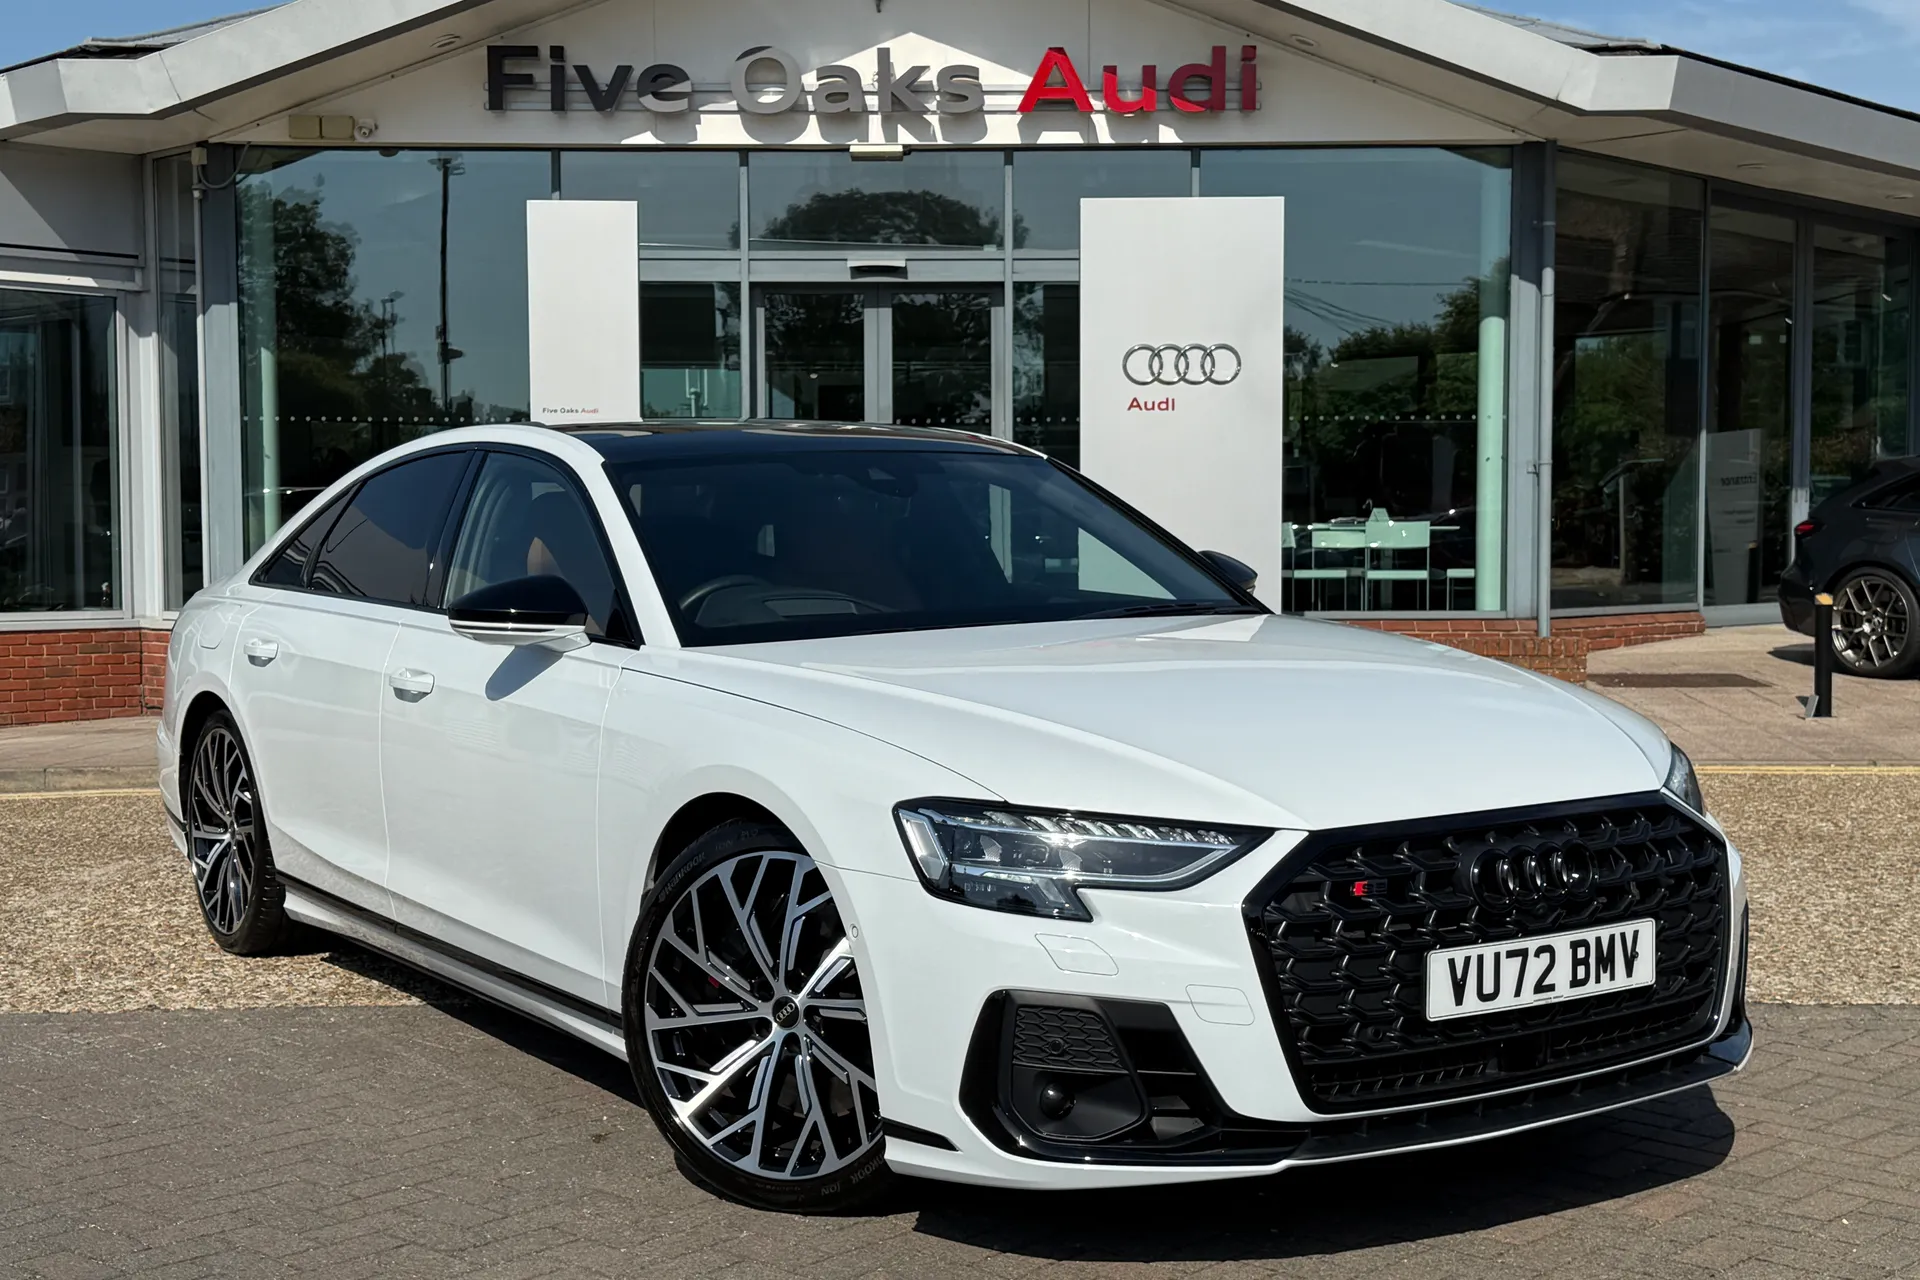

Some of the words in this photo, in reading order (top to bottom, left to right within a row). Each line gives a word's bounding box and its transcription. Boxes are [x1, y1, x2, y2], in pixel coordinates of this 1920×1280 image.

[487, 45, 692, 112] Five
[731, 45, 985, 114] Oaks
[1017, 46, 1257, 114] Audi
[1127, 397, 1175, 411] Audi
[1447, 944, 1556, 1007] VU72
[1569, 930, 1640, 989] BMV
